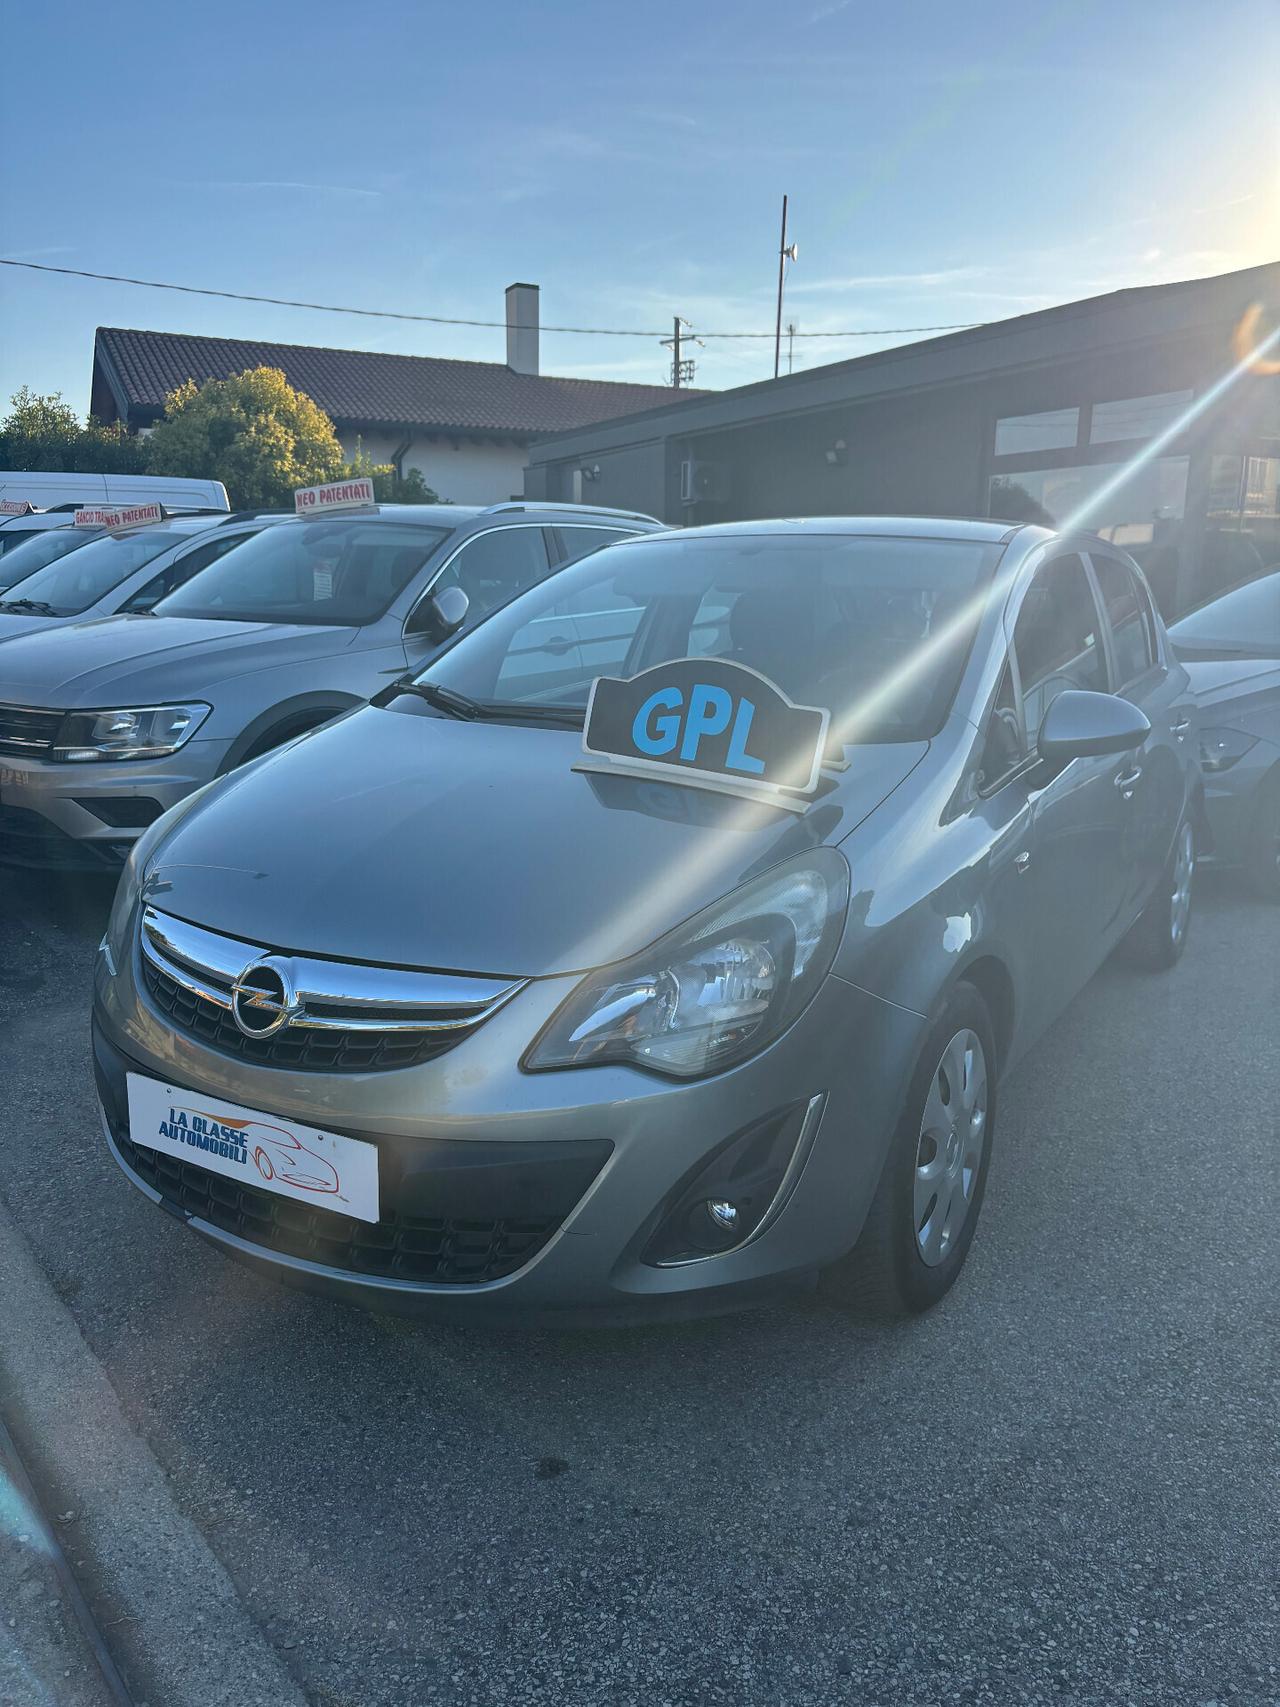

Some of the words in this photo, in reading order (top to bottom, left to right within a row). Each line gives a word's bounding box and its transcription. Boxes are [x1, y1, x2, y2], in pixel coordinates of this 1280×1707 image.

[296, 491, 316, 507] NEO
[319, 484, 371, 504] PATENTATI
[122, 506, 158, 522] PATENTATI
[632, 684, 765, 775] GPL
[170, 1108, 188, 1128] LA
[159, 1121, 248, 1164] AUTOMOBILI
